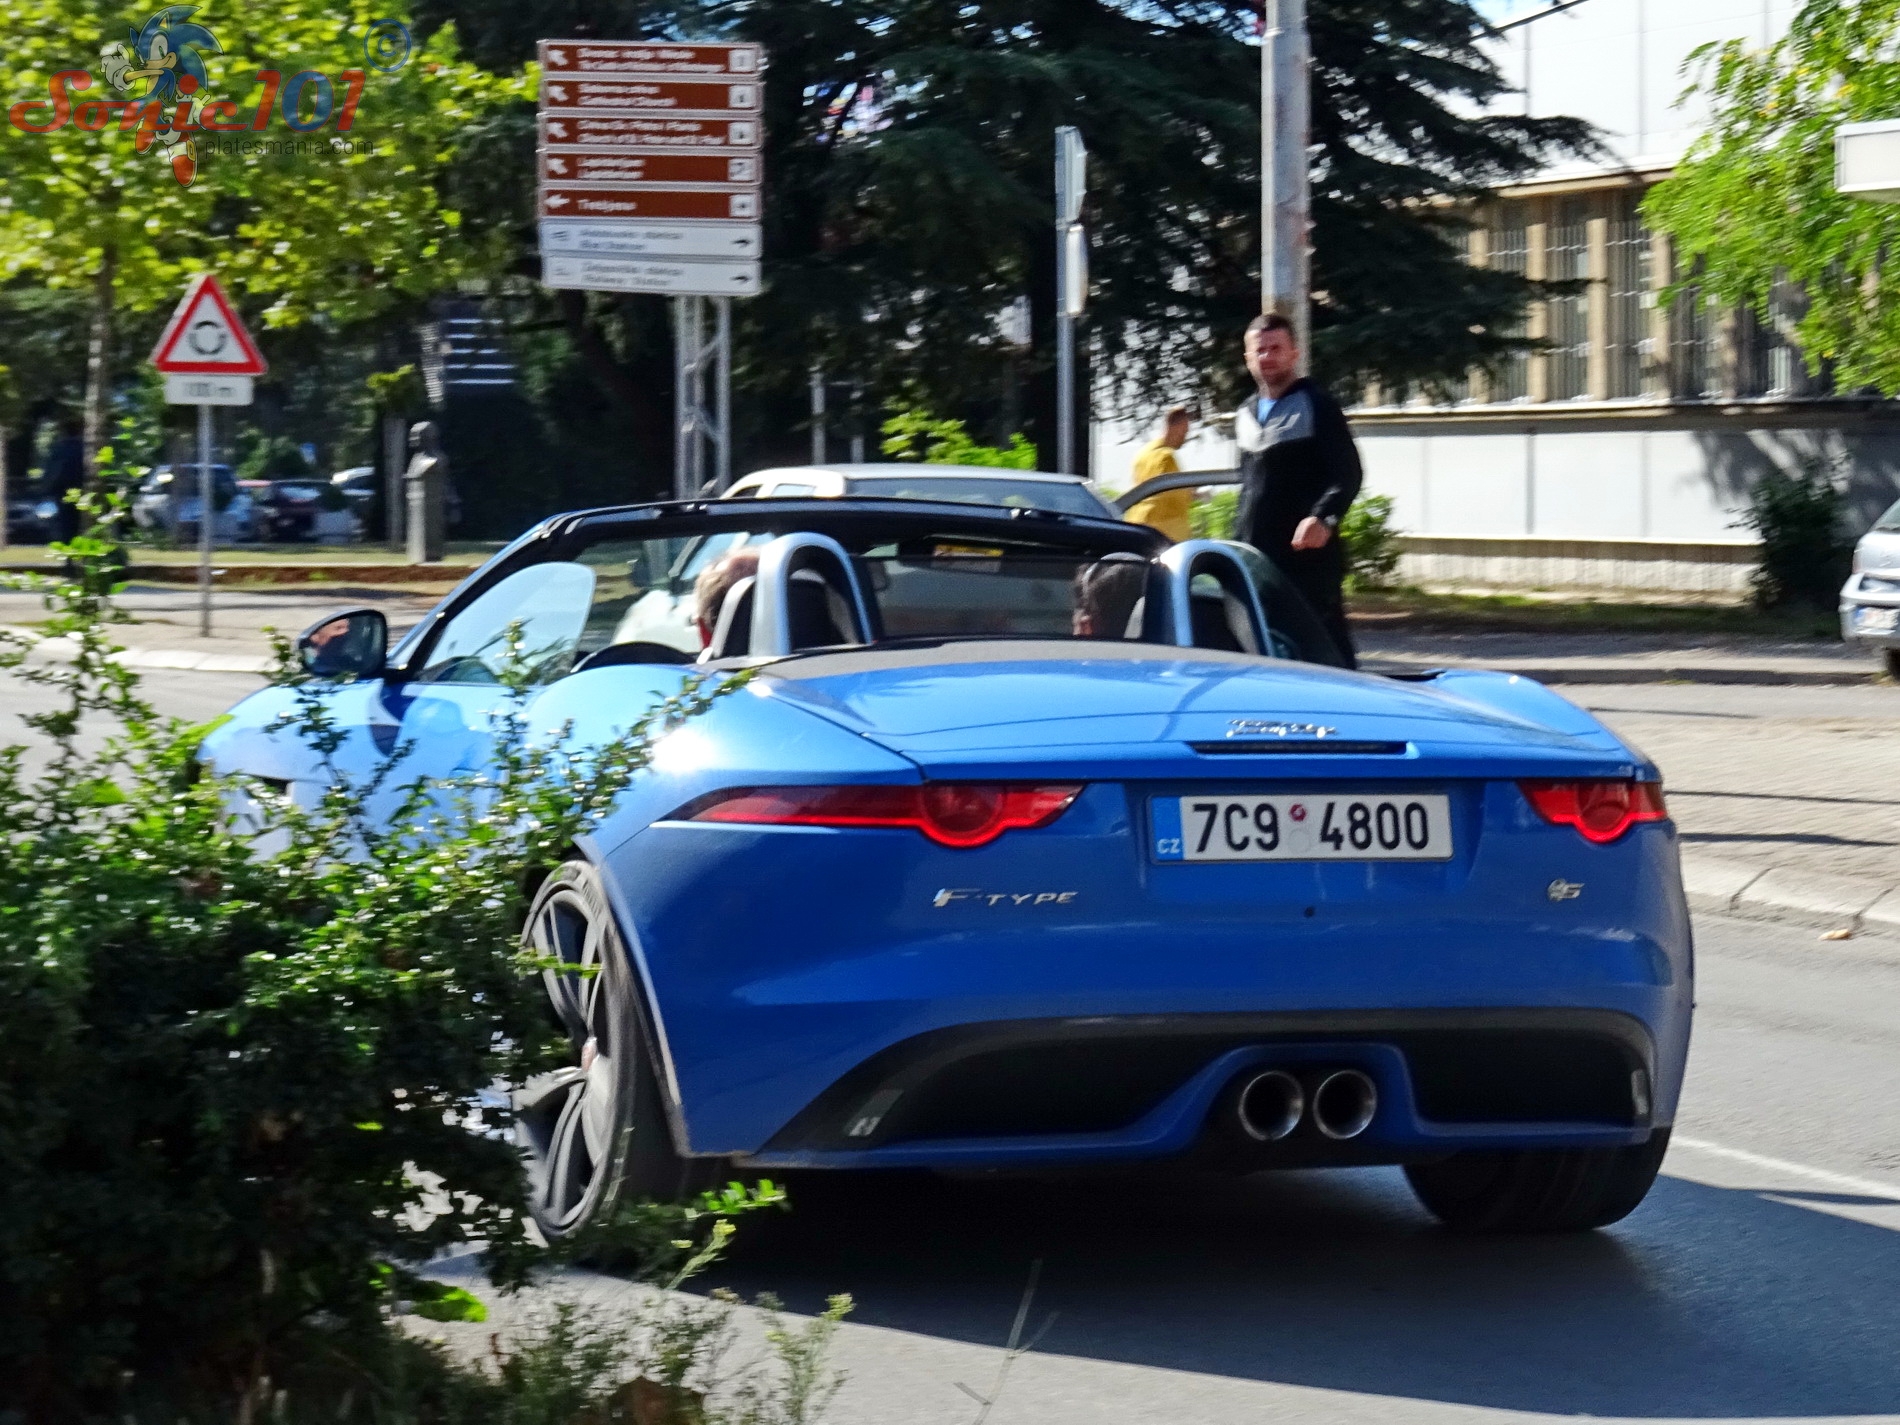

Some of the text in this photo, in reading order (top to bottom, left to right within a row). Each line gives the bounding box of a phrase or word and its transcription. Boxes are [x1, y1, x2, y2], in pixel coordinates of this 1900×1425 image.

[1193, 802, 1430, 853] 7C9 4800
[1157, 838, 1181, 855] CZ
